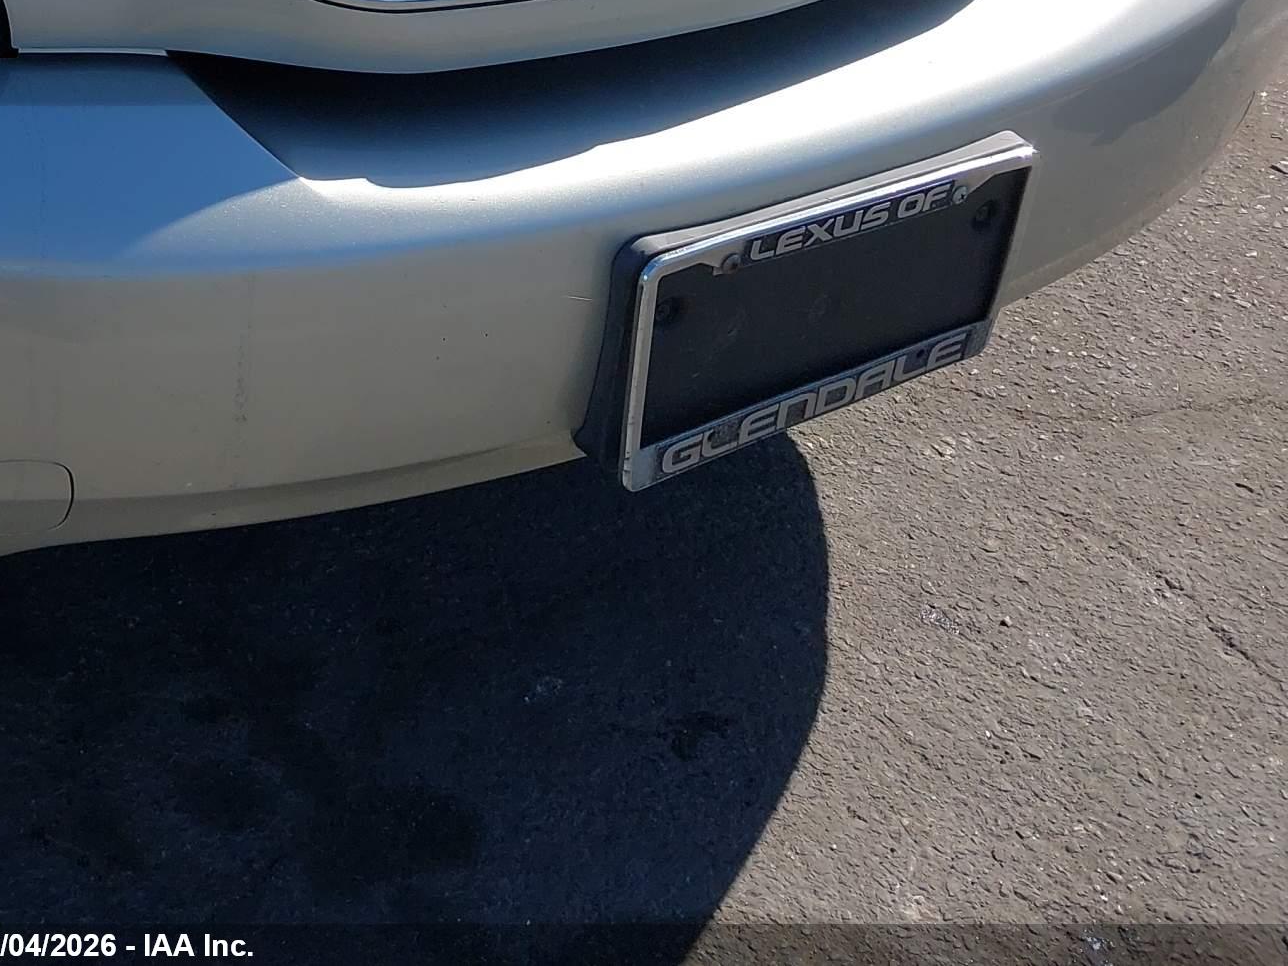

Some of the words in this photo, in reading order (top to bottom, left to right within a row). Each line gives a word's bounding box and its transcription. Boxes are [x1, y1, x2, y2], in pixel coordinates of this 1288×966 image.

[749, 201, 892, 262] LEXUS
[896, 182, 954, 220] OF
[661, 333, 969, 475] GLENDALE
